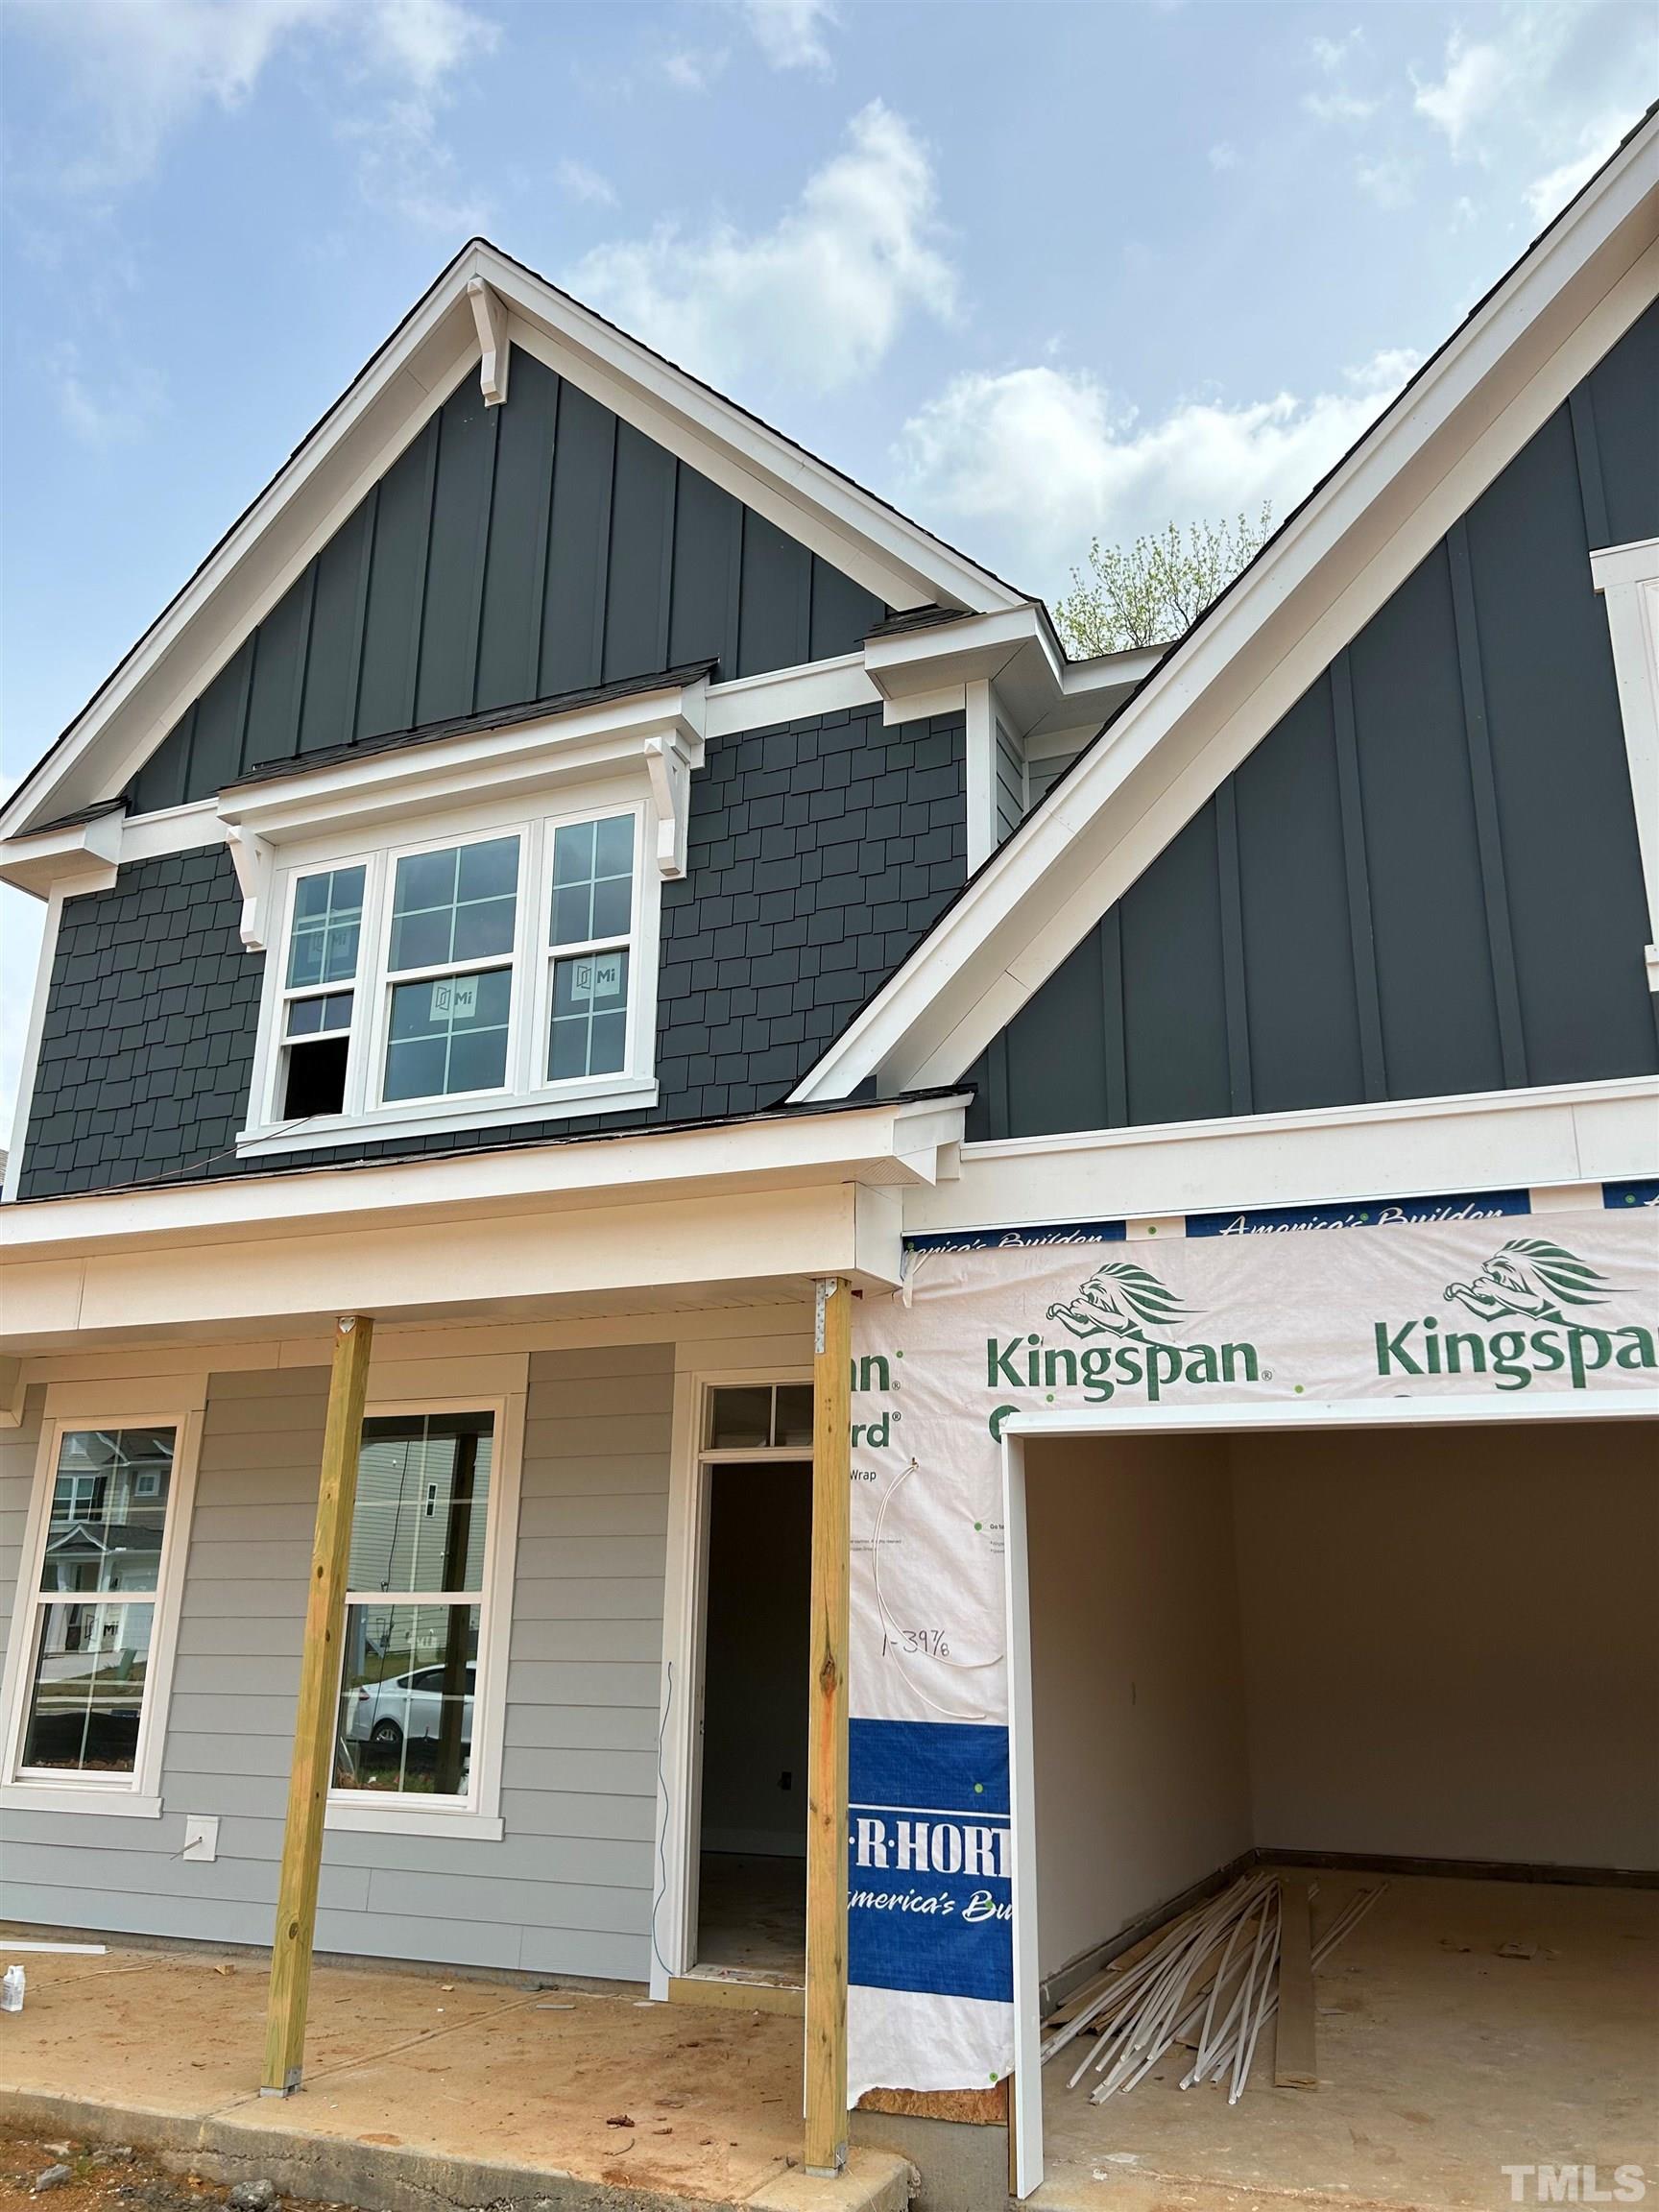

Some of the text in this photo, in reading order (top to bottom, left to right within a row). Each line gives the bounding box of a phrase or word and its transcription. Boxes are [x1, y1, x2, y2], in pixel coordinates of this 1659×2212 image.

[597, 967, 615, 984] Mi
[454, 991, 472, 1006] Mi
[1374, 1316, 1659, 1390] Kingspa
[848, 1888, 955, 1915] merica's
